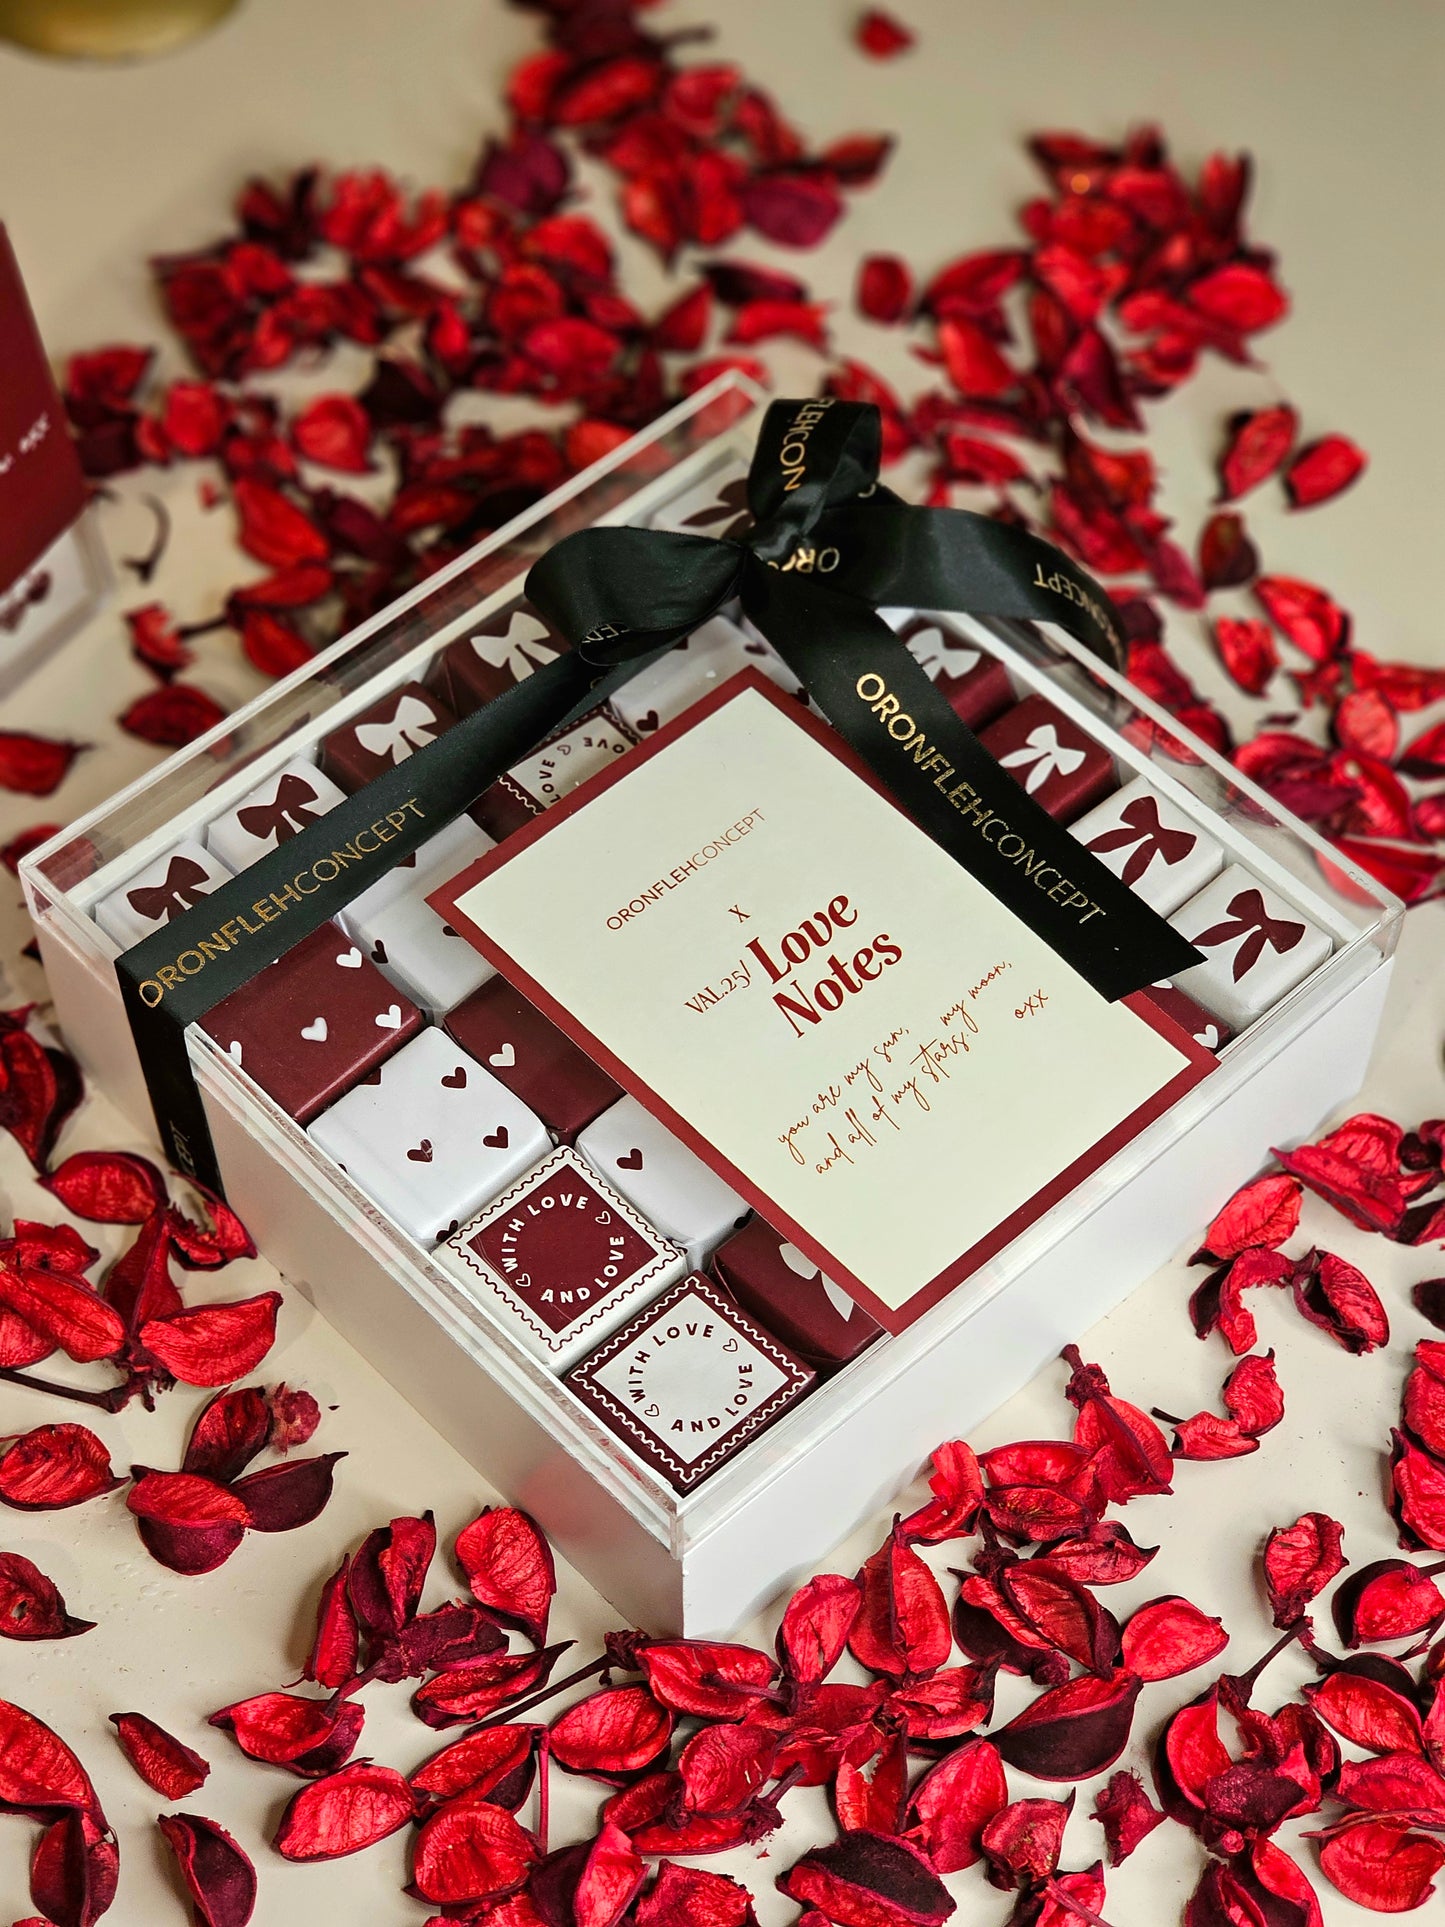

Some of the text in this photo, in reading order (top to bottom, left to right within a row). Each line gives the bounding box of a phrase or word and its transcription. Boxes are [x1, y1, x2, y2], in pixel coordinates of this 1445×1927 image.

[583, 737, 626, 755] OVE
[856, 672, 1107, 924] ORONFLEHCONCEPT
[138, 797, 426, 1008] ORONFLEHCONCEPT
[606, 807, 767, 932] ORONFLEHCONCEPT
[745, 892, 859, 985] Love
[772, 931, 903, 1040] Notes
[1013, 988, 1050, 1020] oxx
[776, 960, 1013, 1166] you are my sun, my moon,
[816, 1032, 971, 1175] and all of my stars.
[501, 1192, 589, 1273] WITH LOVE
[540, 1235, 625, 1304] AND LOVE
[628, 1322, 715, 1404] WITH LOVE
[671, 1362, 753, 1433] AND LOVE
